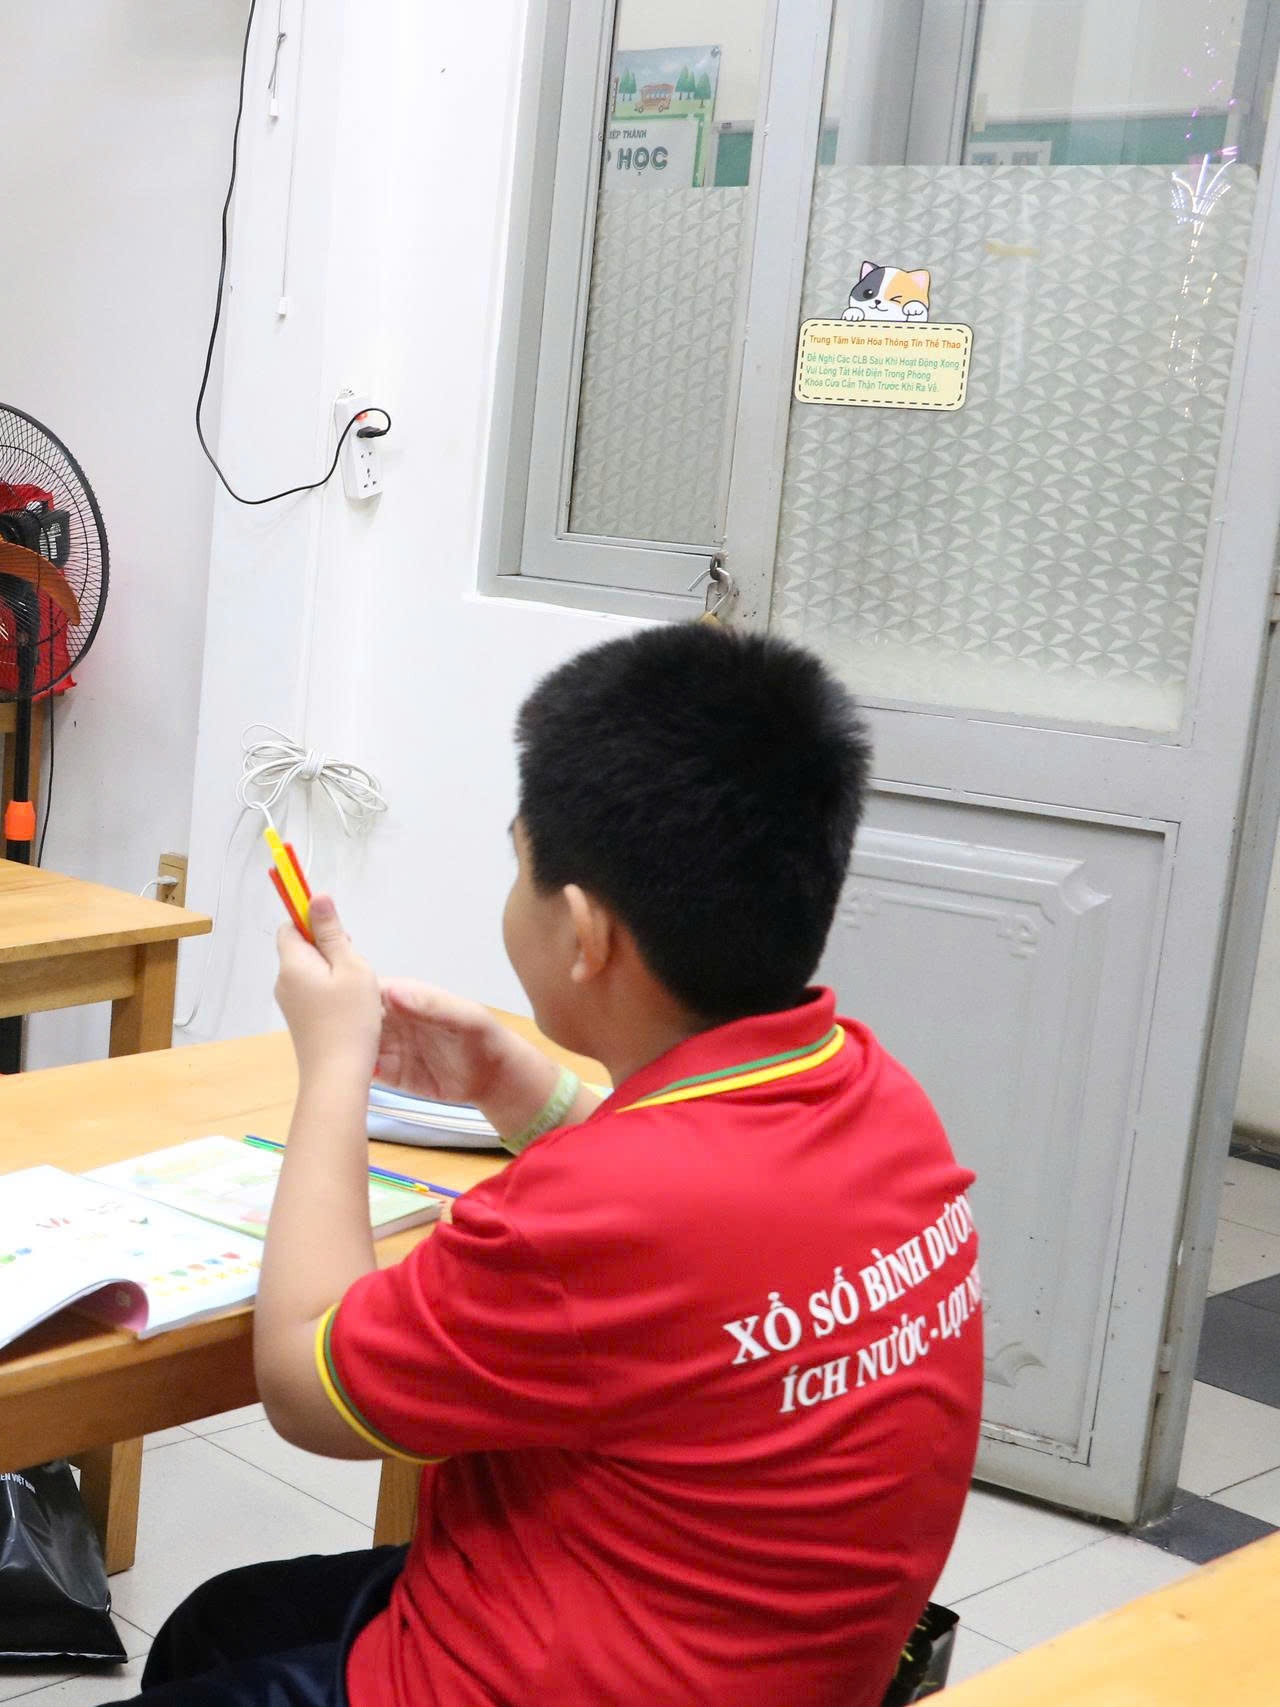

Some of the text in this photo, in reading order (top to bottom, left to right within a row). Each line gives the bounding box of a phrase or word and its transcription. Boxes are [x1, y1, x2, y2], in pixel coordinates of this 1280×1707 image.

[616, 146, 668, 176] HỌC
[809, 335, 831, 346] Trung
[833, 335, 849, 345] Tâm
[884, 337, 909, 349] Thông
[911, 338, 924, 348] Tin
[925, 337, 939, 348] Thể
[941, 339, 961, 349] Thao
[852, 355, 867, 364] CLB
[869, 355, 884, 365] Sau
[885, 356, 898, 365] Khi
[940, 359, 960, 370] Xong
[806, 365, 817, 375] Vui
[884, 368, 906, 380] Trong
[901, 382, 914, 391] Khi
[915, 382, 926, 392] Ra
[722, 1291, 802, 1366] XỔ
[808, 1266, 860, 1338] SỐ
[858, 1247, 931, 1313] BÌNH
[779, 1364, 851, 1414] ÍCH
